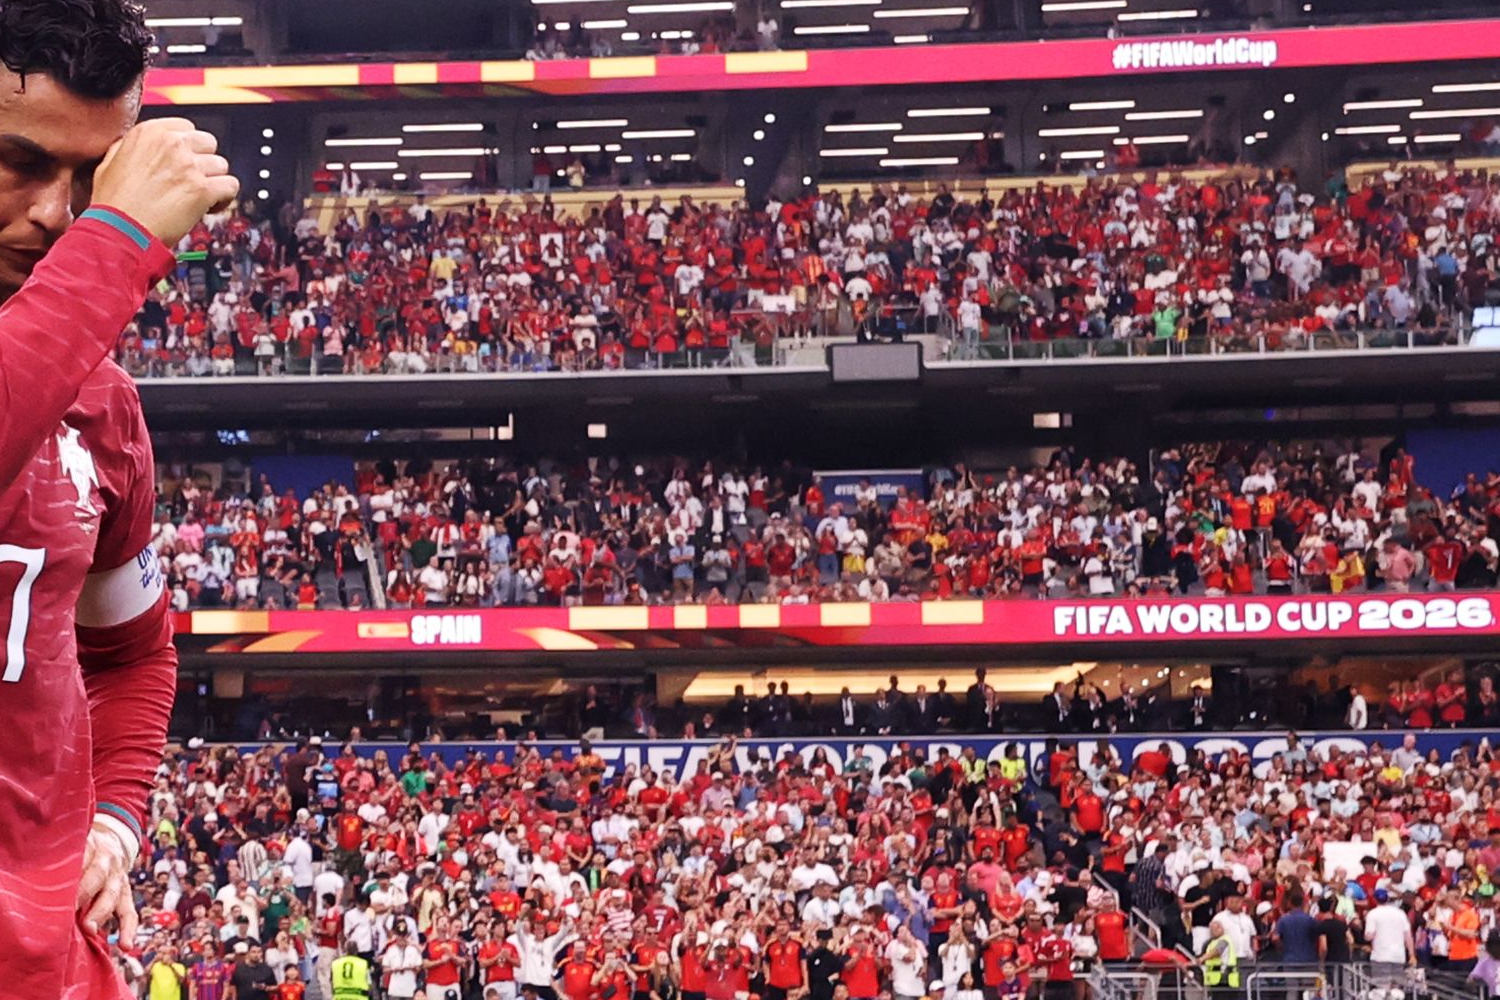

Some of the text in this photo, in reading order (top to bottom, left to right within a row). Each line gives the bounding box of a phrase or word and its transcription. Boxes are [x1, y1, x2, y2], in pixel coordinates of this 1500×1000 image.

[1112, 37, 1277, 69] #FIFAWorldCup
[411, 615, 482, 645] SPAIN
[1053, 598, 1491, 635] FIFA WORLD CUP 2026
